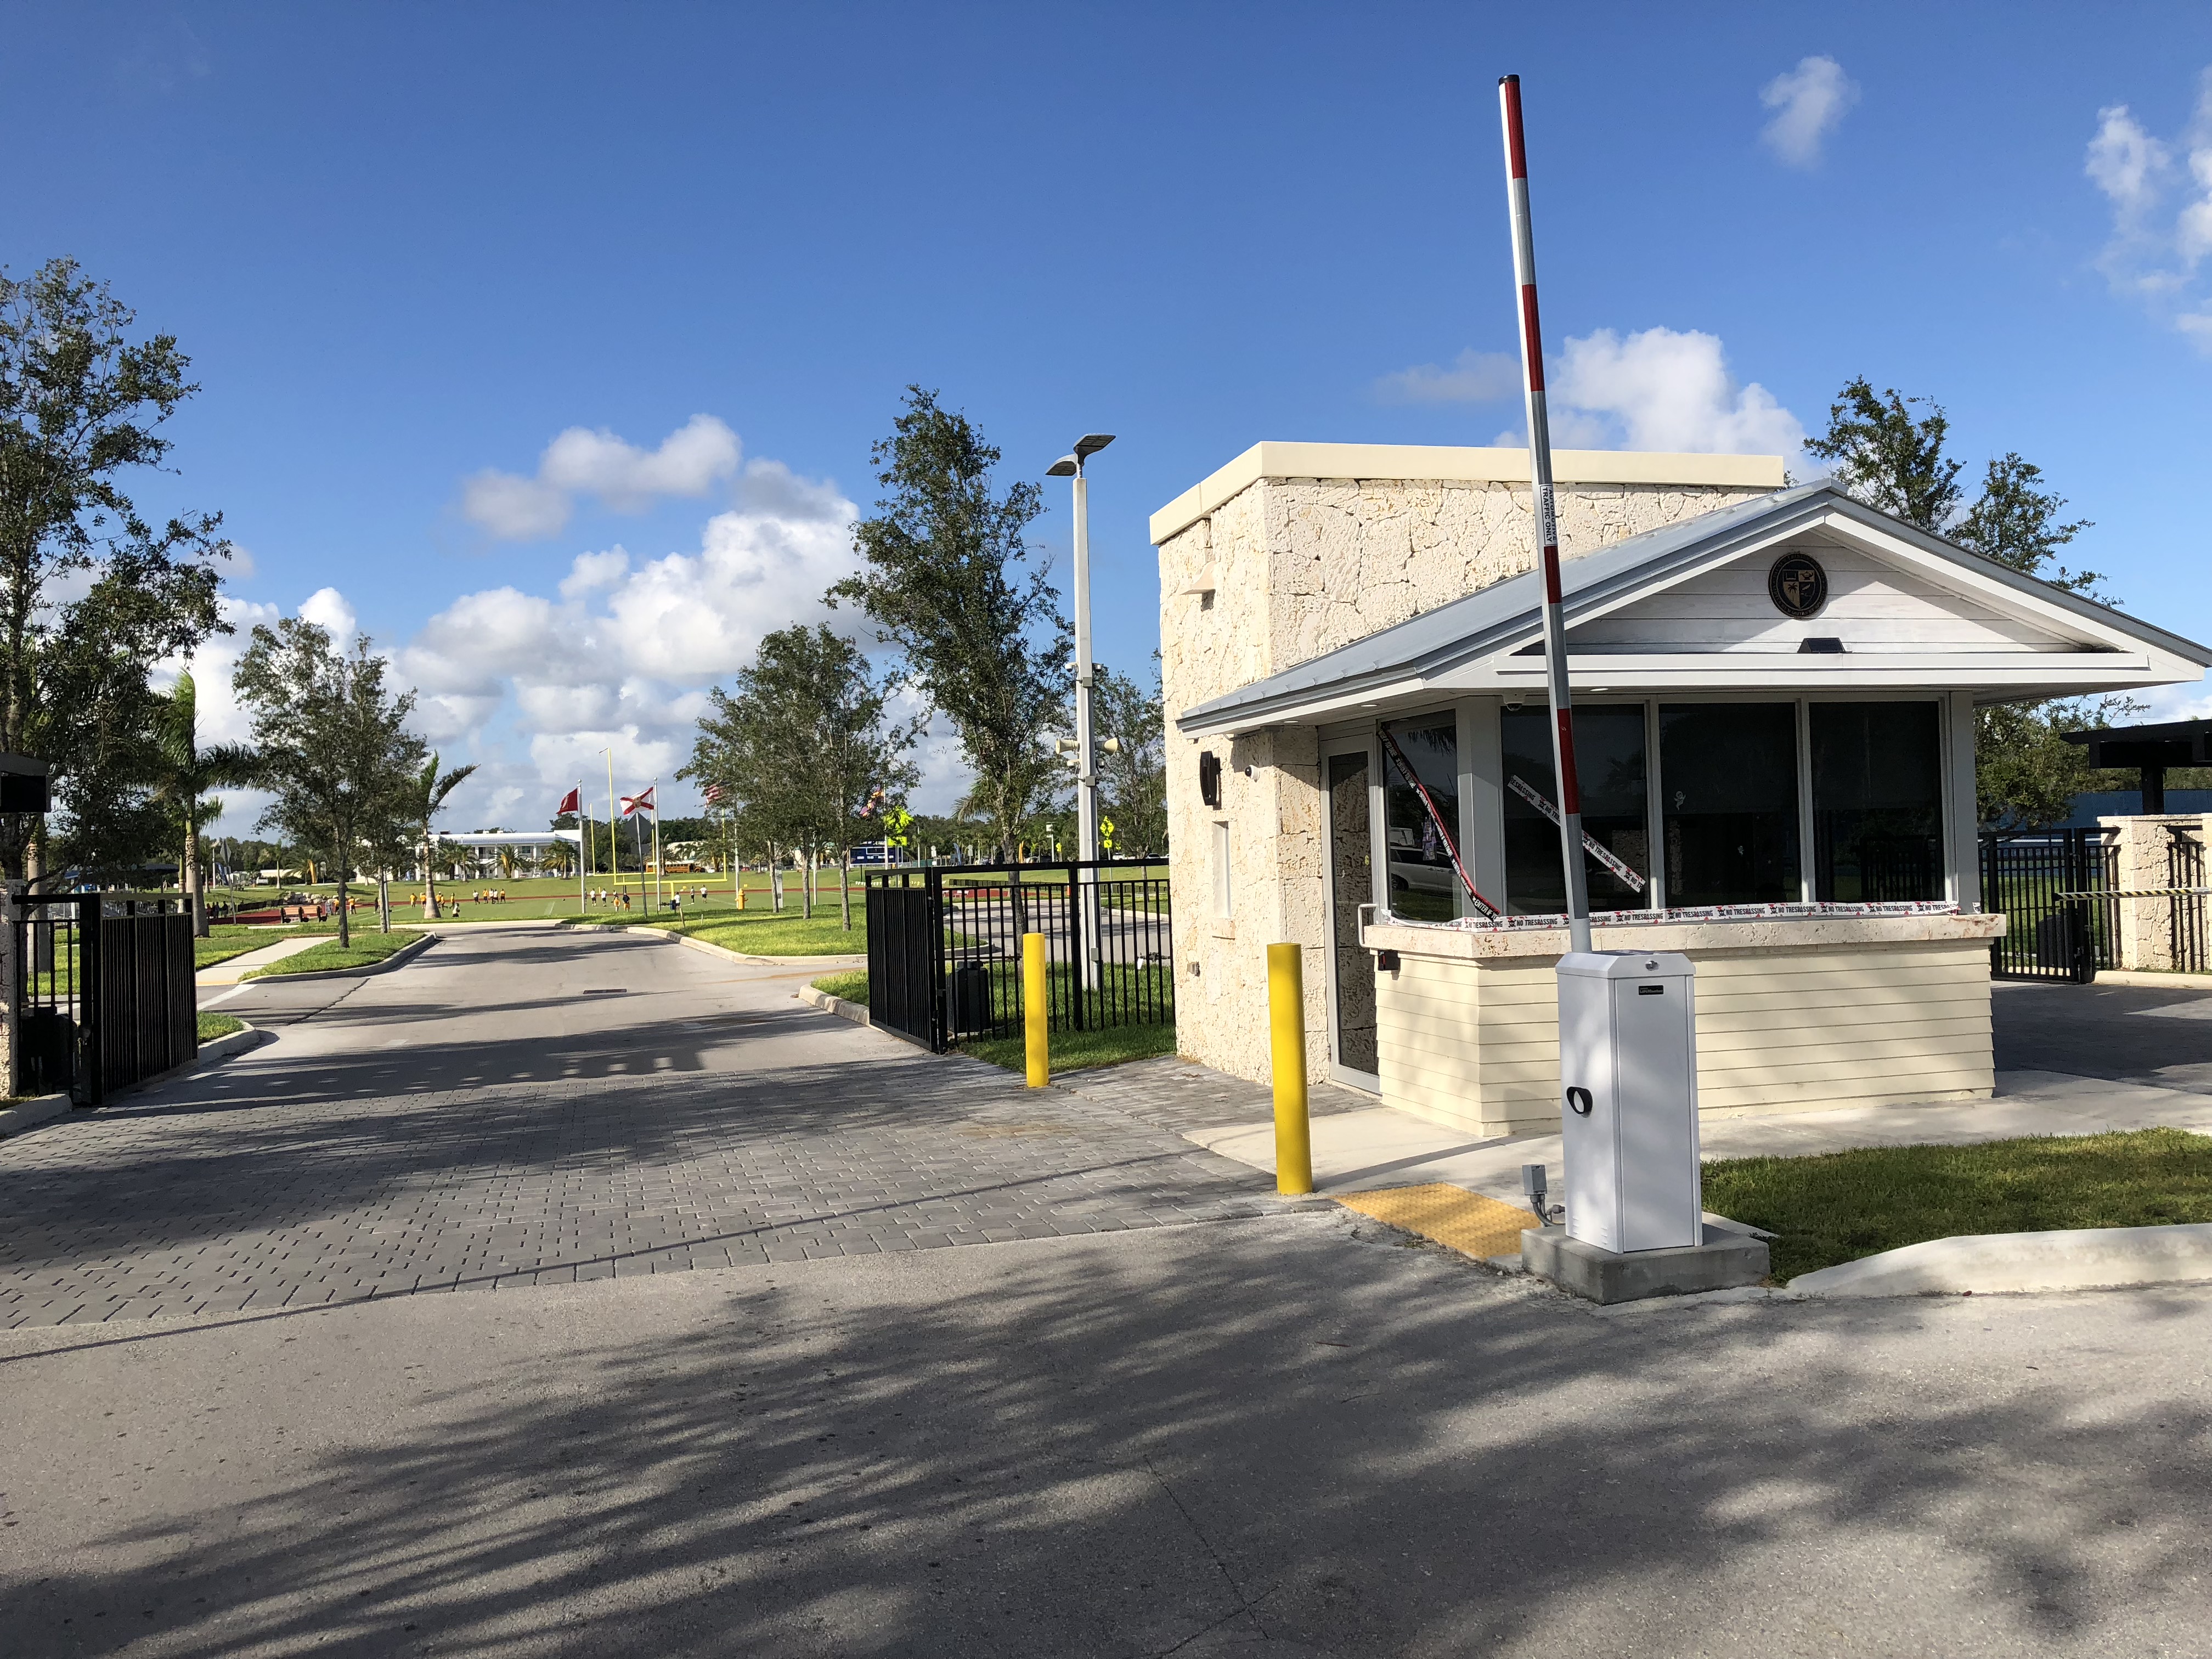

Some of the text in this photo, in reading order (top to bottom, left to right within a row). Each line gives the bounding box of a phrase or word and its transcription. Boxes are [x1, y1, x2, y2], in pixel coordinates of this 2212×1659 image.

[1542, 487, 1550, 520] TRAFFIC
[1549, 489, 1557, 541] AUTOMOTIVE
[1510, 778, 1536, 800] RESPASSING
[1594, 845, 1622, 871] TRESPASSING
[1474, 899, 1488, 913] ENTER
[1525, 918, 1558, 926] TRESPASSING
